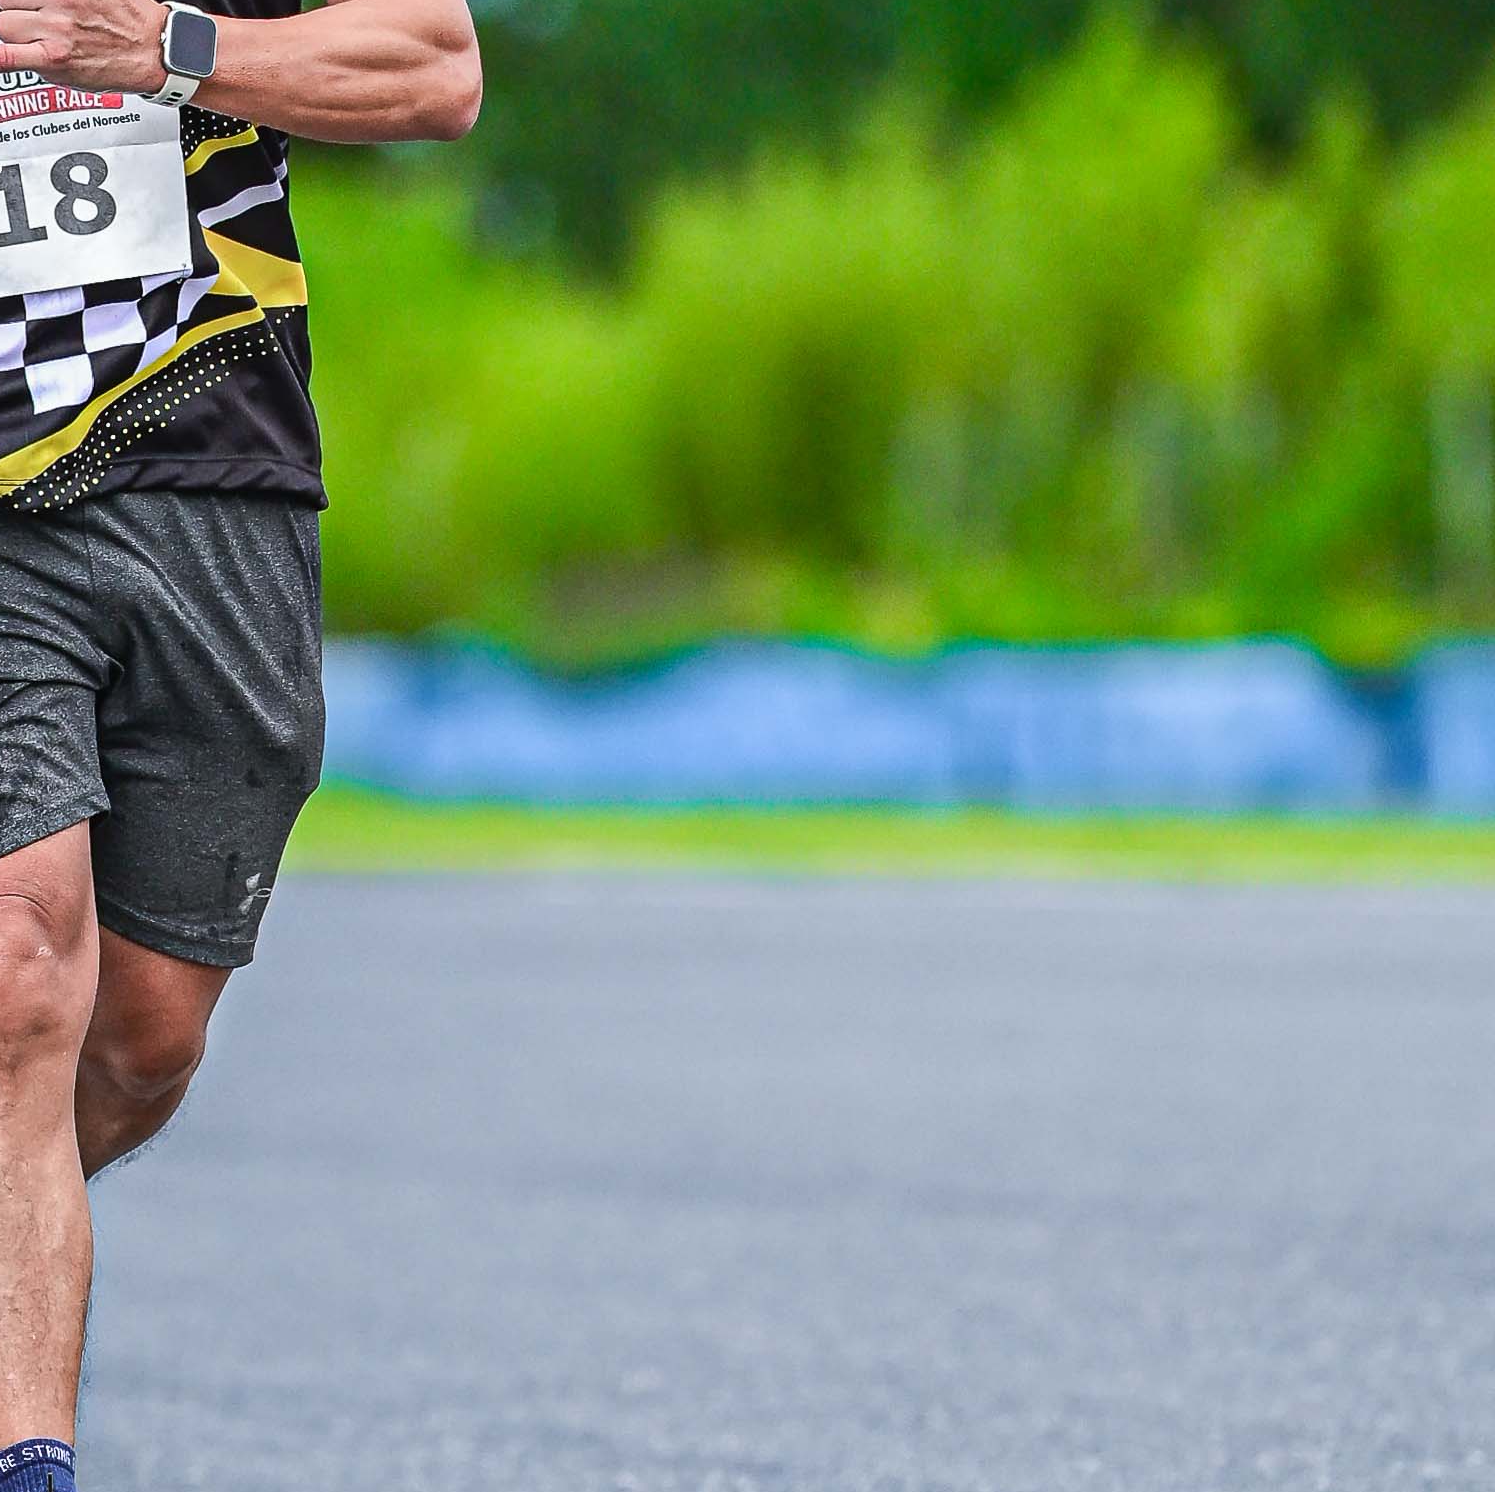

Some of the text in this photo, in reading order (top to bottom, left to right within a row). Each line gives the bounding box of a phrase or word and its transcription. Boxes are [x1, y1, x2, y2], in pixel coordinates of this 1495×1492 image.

[12, 128, 30, 141] los
[31, 122, 71, 138] Clubes
[72, 118, 91, 130] del
[92, 111, 142, 128] Noroeste
[21, 1444, 71, 1467] STRONG
